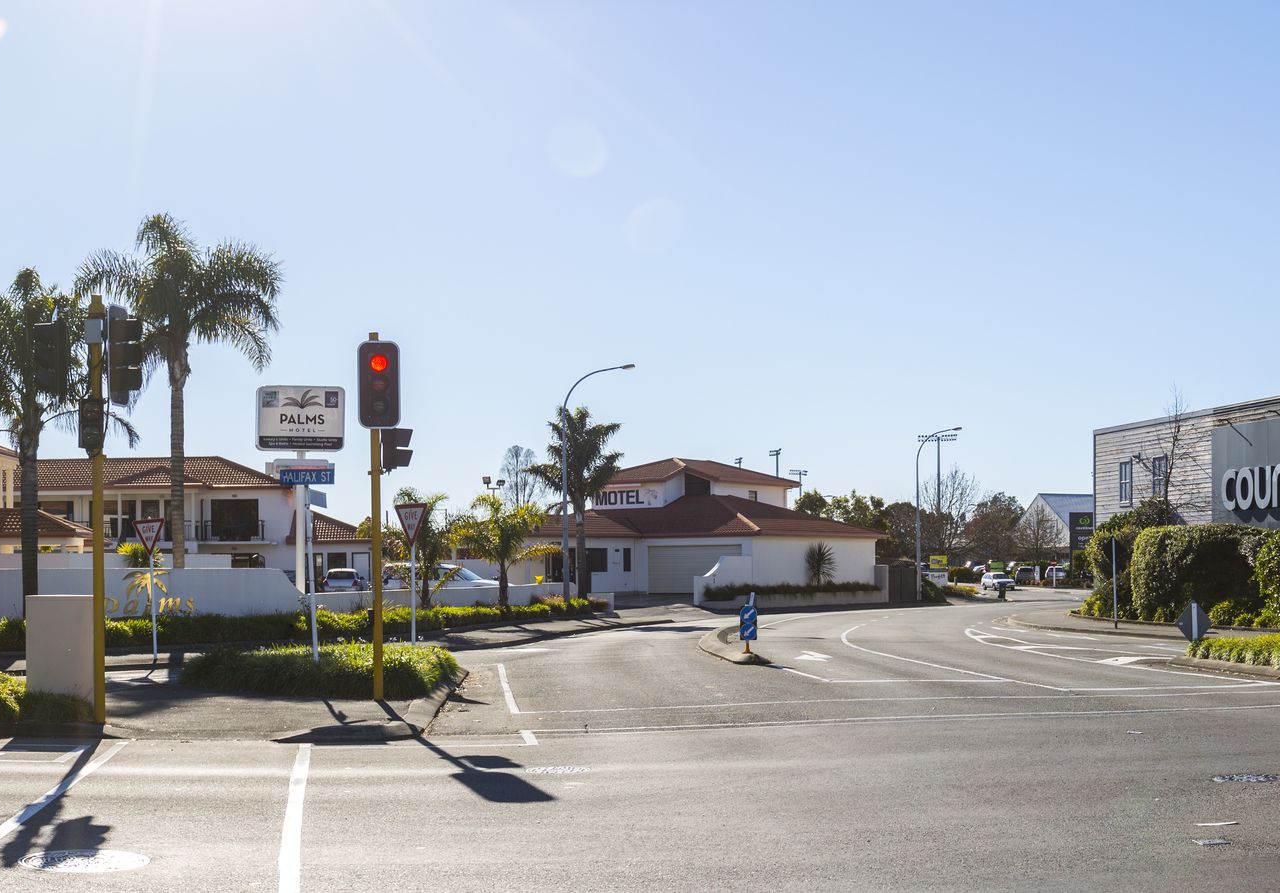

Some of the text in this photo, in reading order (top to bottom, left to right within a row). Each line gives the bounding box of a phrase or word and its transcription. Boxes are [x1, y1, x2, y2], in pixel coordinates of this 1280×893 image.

[280, 413, 325, 425] PALMS
[283, 471, 332, 483] HALIFAX ST
[595, 489, 645, 506] MOTEL
[405, 512, 417, 520] GIVE
[142, 525, 155, 534] GIVE
